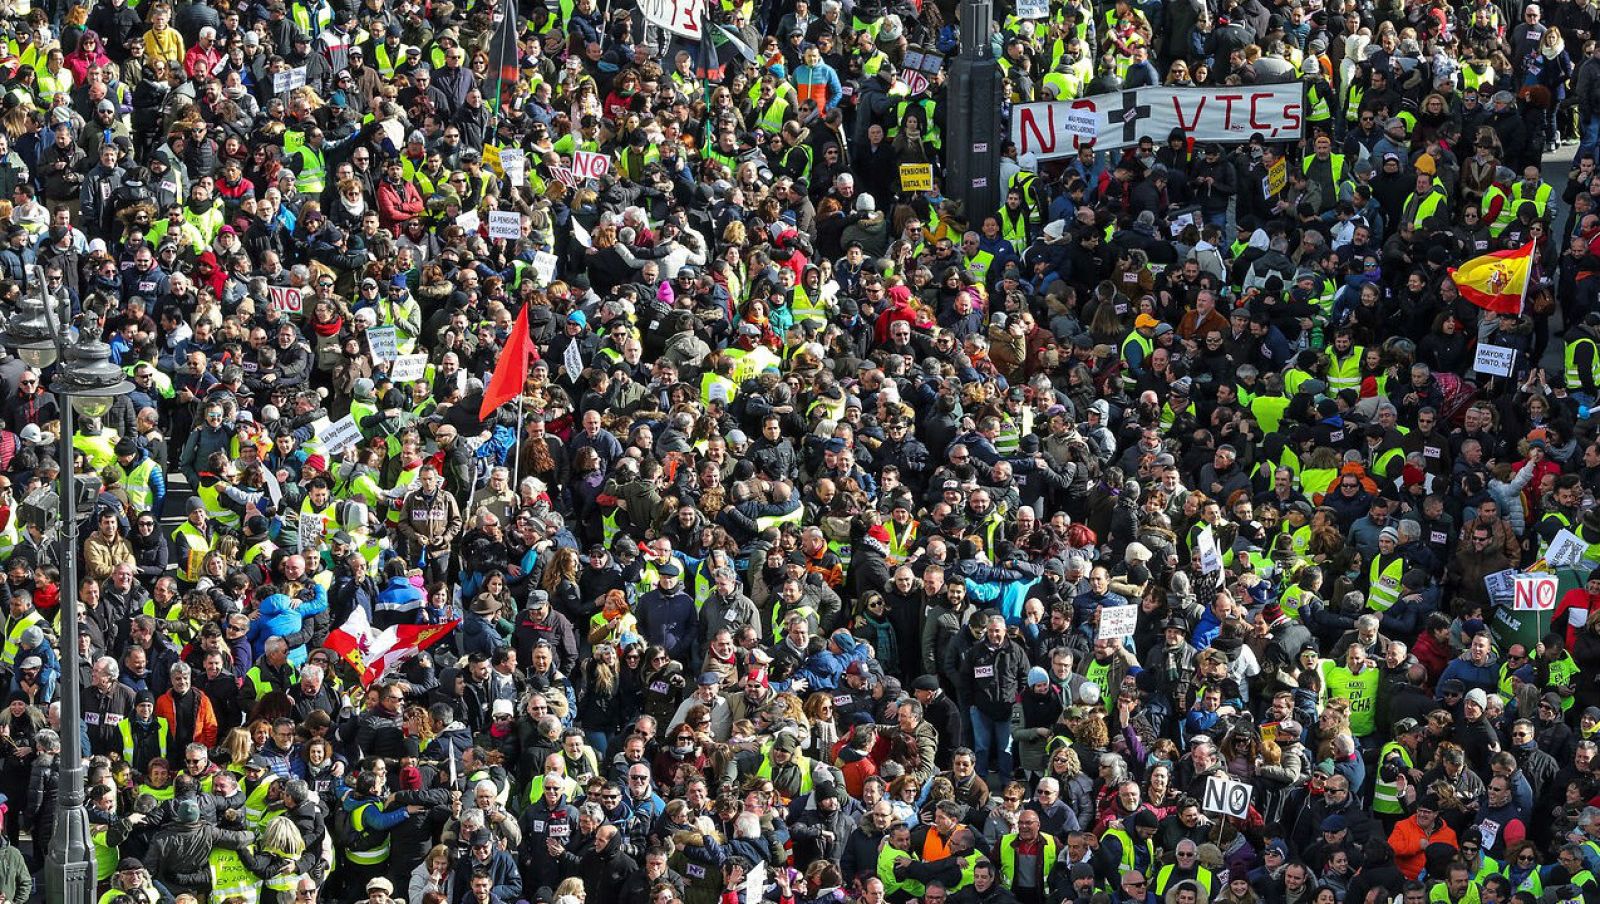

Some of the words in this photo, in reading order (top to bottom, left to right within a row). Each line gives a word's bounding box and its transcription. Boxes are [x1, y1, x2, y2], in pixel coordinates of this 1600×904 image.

[903, 69, 927, 93] NO
[574, 152, 607, 177] NO
[900, 167, 929, 175] PENSIONES
[550, 167, 576, 188] NO
[496, 227, 519, 235] DERECHO
[271, 287, 301, 311] NO
[320, 435, 329, 443] Los
[1515, 579, 1555, 609] NO
[1349, 690, 1362, 699] EN
[1350, 697, 1370, 711] CHA
[1205, 779, 1248, 815] NO
[1484, 820, 1498, 829] NO+
